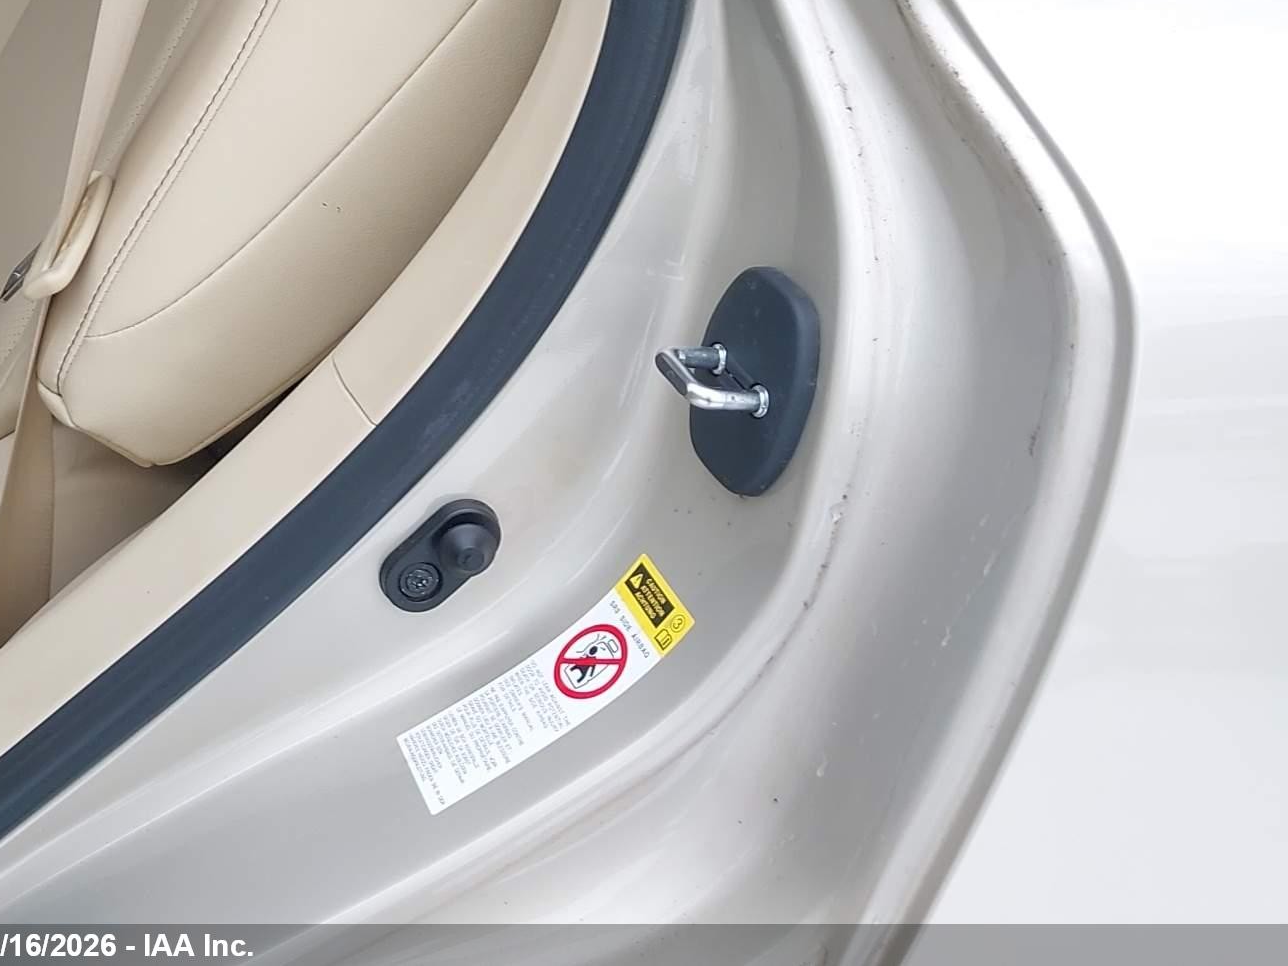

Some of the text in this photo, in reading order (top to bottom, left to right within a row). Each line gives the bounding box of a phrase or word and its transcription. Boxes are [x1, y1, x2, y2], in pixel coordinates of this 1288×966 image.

[634, 590, 657, 620] ACHTUNG
[640, 584, 666, 617] ATTENTION
[646, 578, 667, 605] CAUTION
[630, 632, 650, 659] AIRBAG
